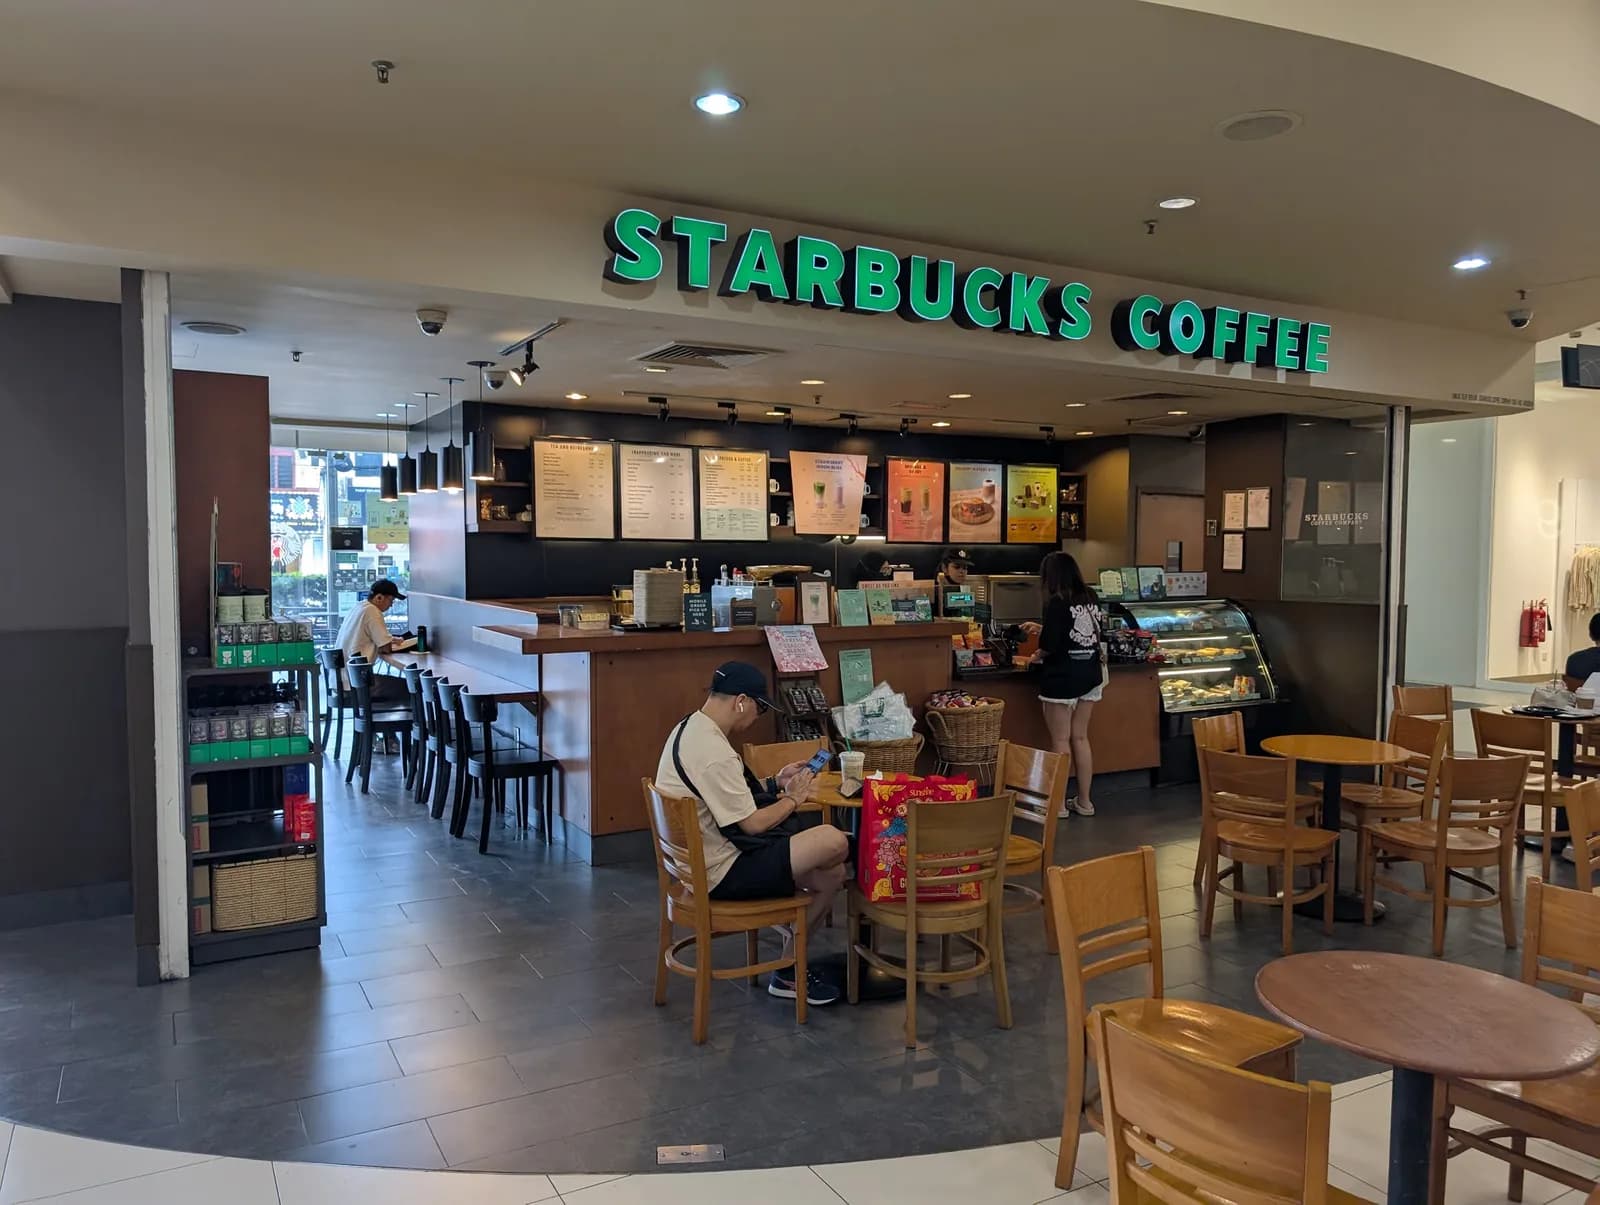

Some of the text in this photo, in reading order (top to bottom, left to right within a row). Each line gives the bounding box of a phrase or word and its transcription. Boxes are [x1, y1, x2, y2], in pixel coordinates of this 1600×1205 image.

[612, 207, 1331, 374] STARBUCKS COFFEE
[1304, 512, 1368, 521] STARBUCKS
